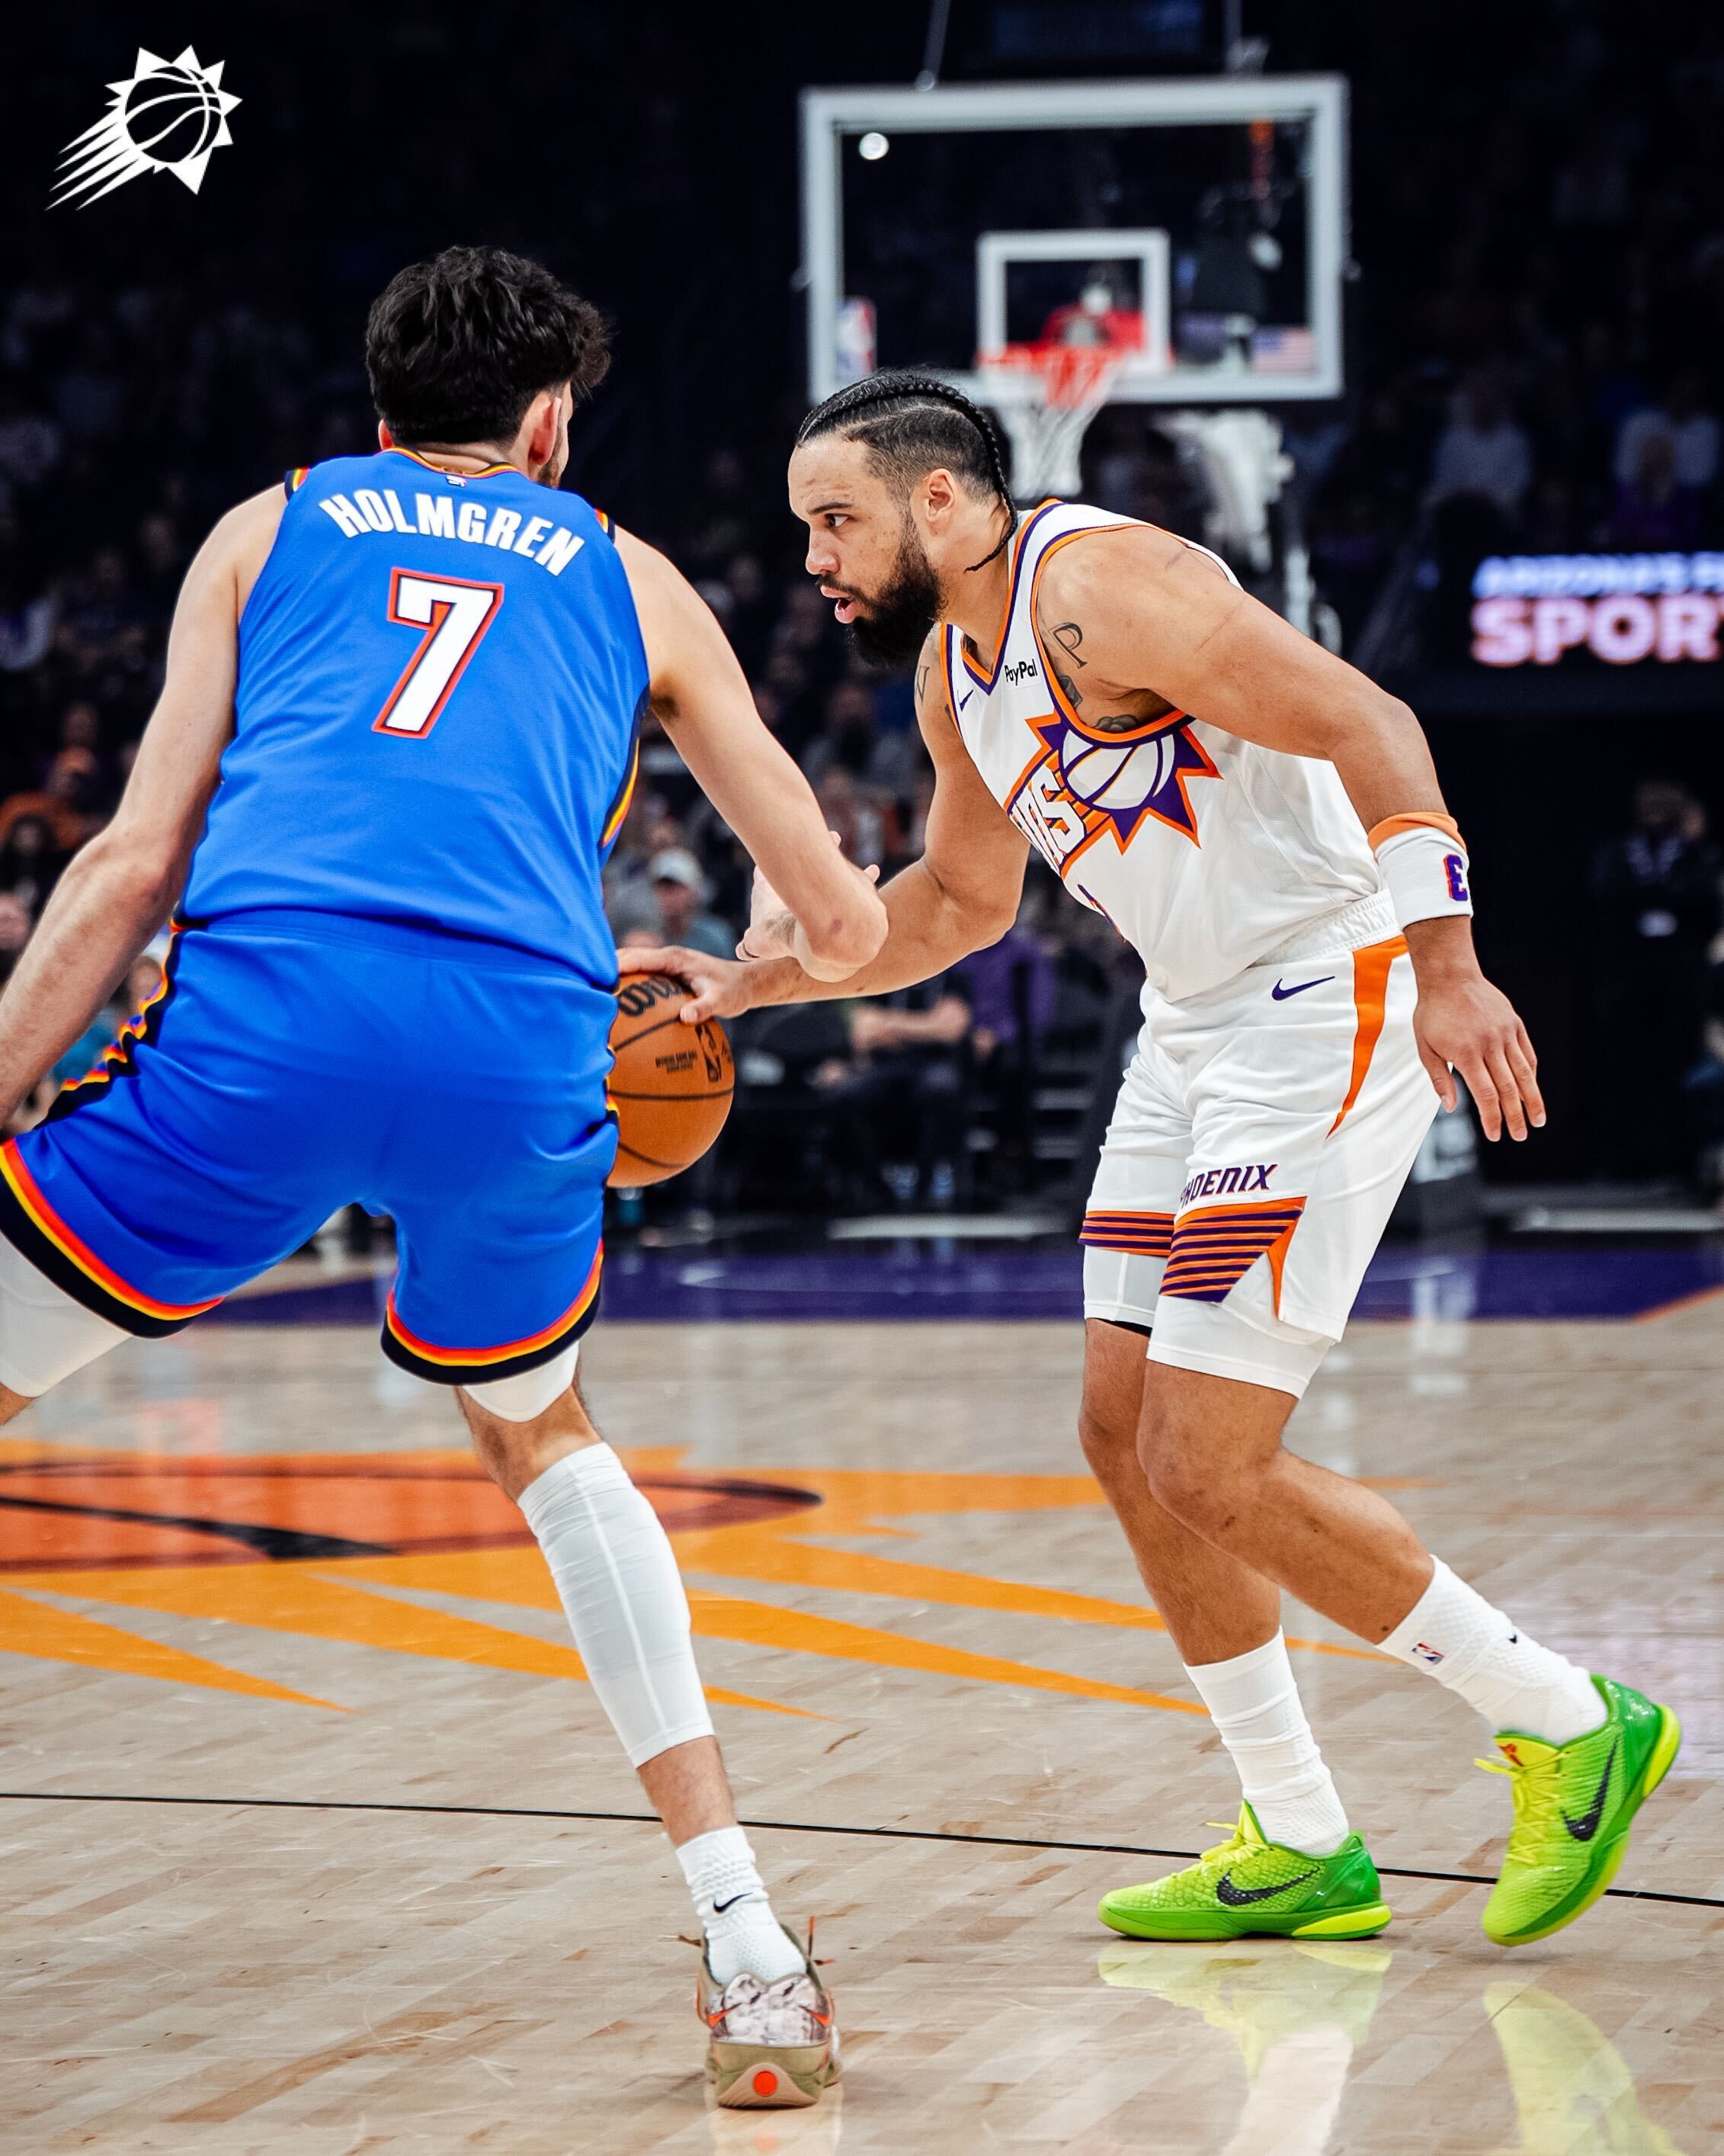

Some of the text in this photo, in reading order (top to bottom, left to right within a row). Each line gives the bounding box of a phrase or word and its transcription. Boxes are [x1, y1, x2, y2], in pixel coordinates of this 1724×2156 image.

[319, 489, 585, 576] HOLMGREN
[371, 566, 505, 739] 7
[1471, 592, 1724, 666] SPOR
[1004, 658, 1038, 686] PayPal
